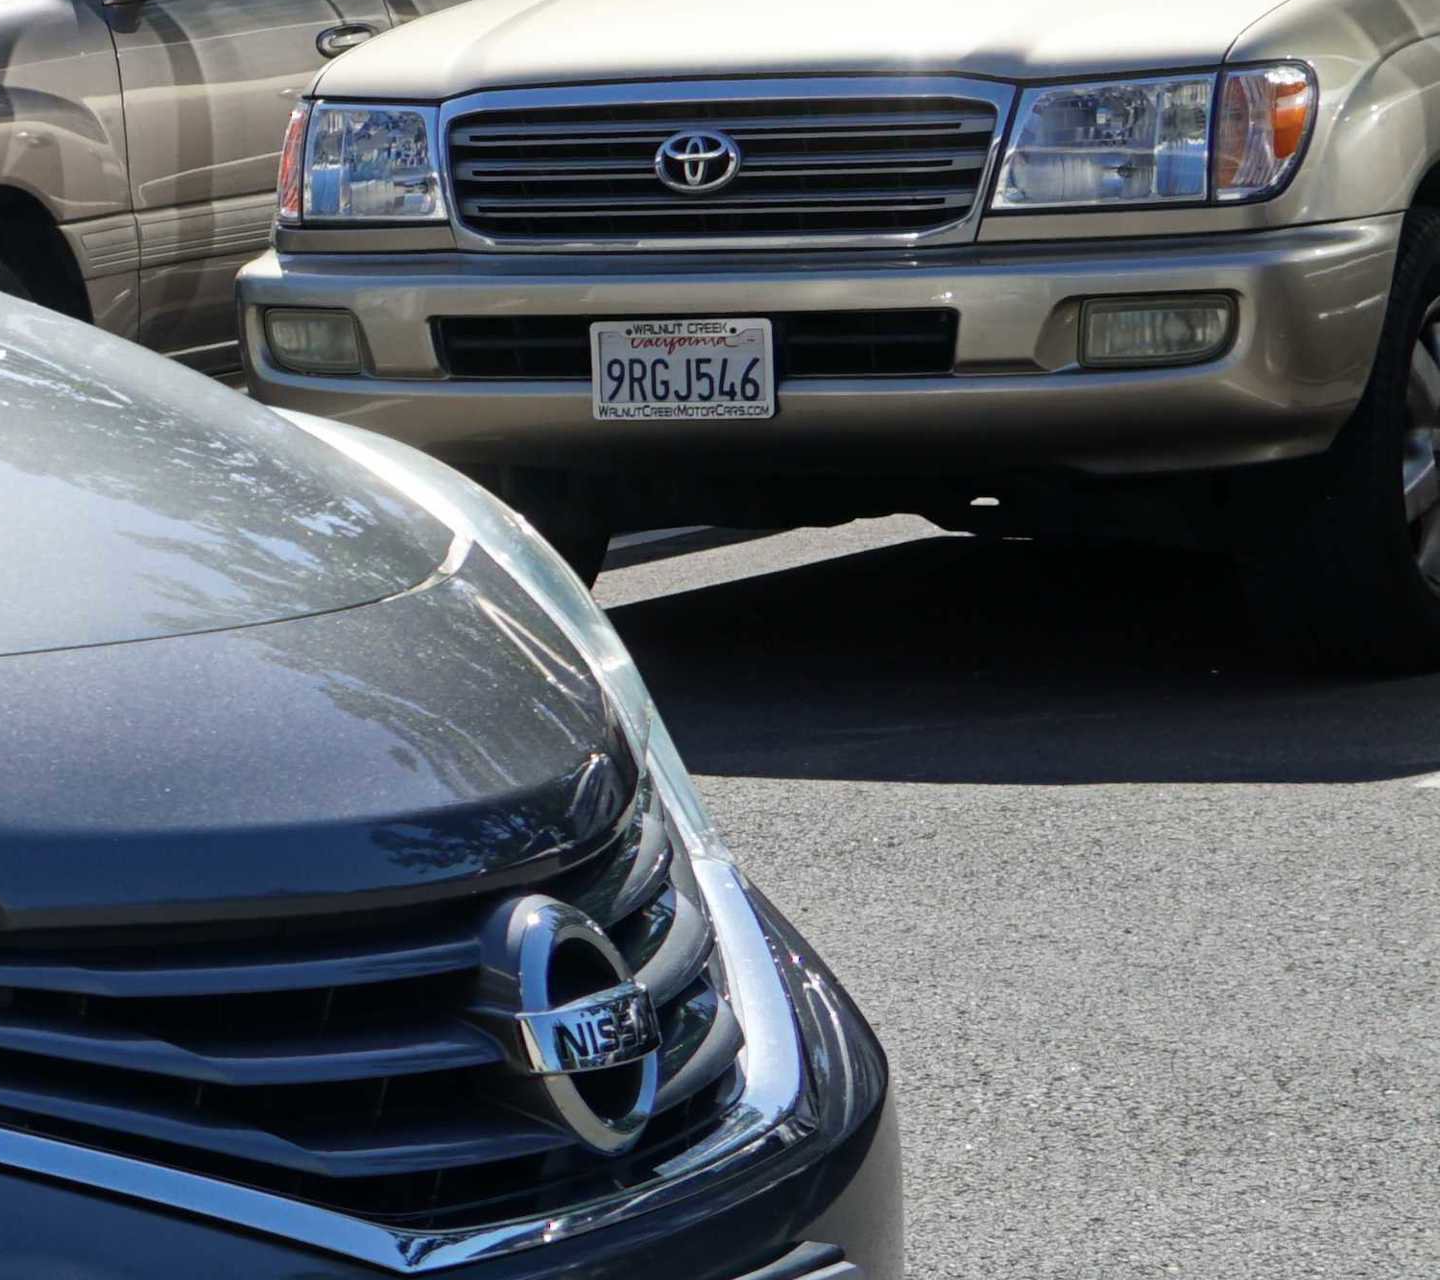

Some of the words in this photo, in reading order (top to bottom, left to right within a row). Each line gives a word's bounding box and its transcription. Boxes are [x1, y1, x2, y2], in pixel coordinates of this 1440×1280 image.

[632, 322, 682, 335] WALNUT
[687, 321, 729, 334] CREEK
[606, 357, 761, 402] 9RGJ546
[552, 1016, 652, 1061] NIS
